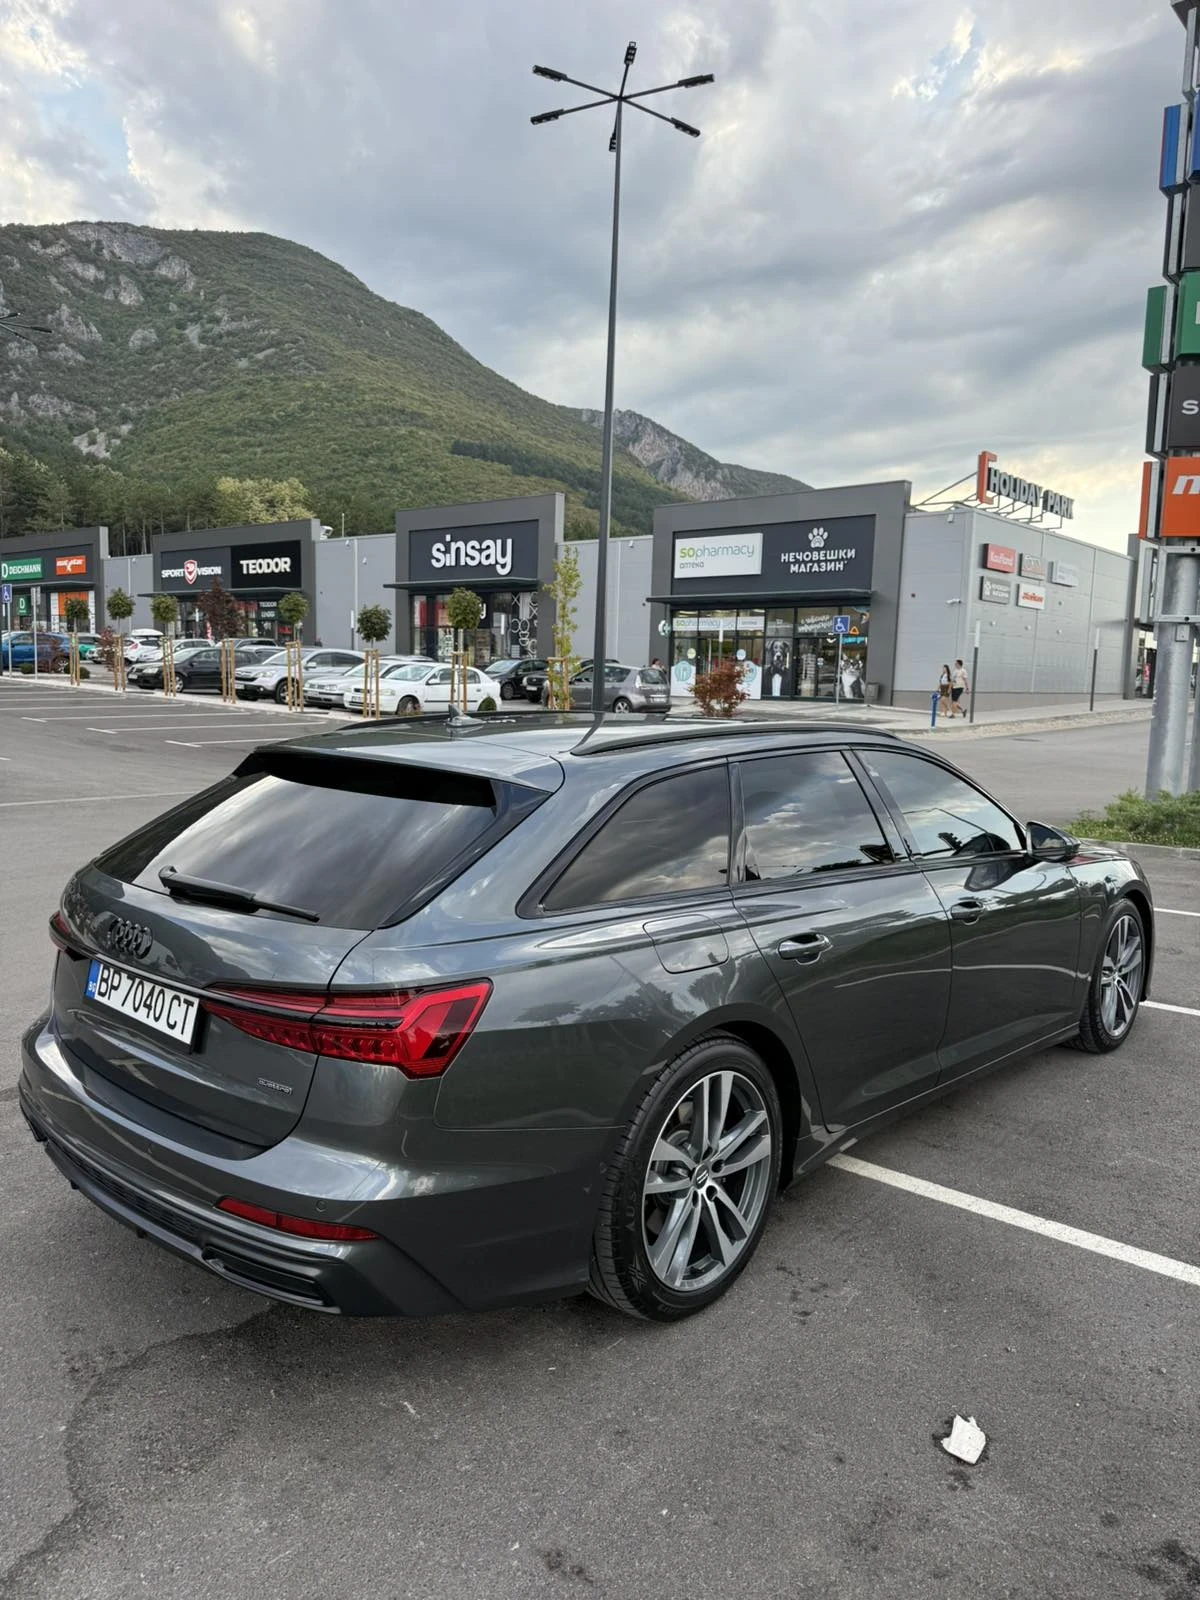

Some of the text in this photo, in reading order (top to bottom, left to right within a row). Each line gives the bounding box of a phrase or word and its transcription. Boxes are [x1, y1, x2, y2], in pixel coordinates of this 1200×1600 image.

[988, 467, 1074, 519] HOLIDAY PARK
[431, 534, 513, 576] sinsay
[679, 544, 755, 560] sopharmacy
[781, 548, 856, 563] НЕЧОВЕШКИ
[9, 564, 41, 575] DEICHMANN
[161, 566, 222, 578] SPORT VISION
[240, 557, 291, 574] TEODOR
[98, 965, 195, 1036] BP 7040 CT
